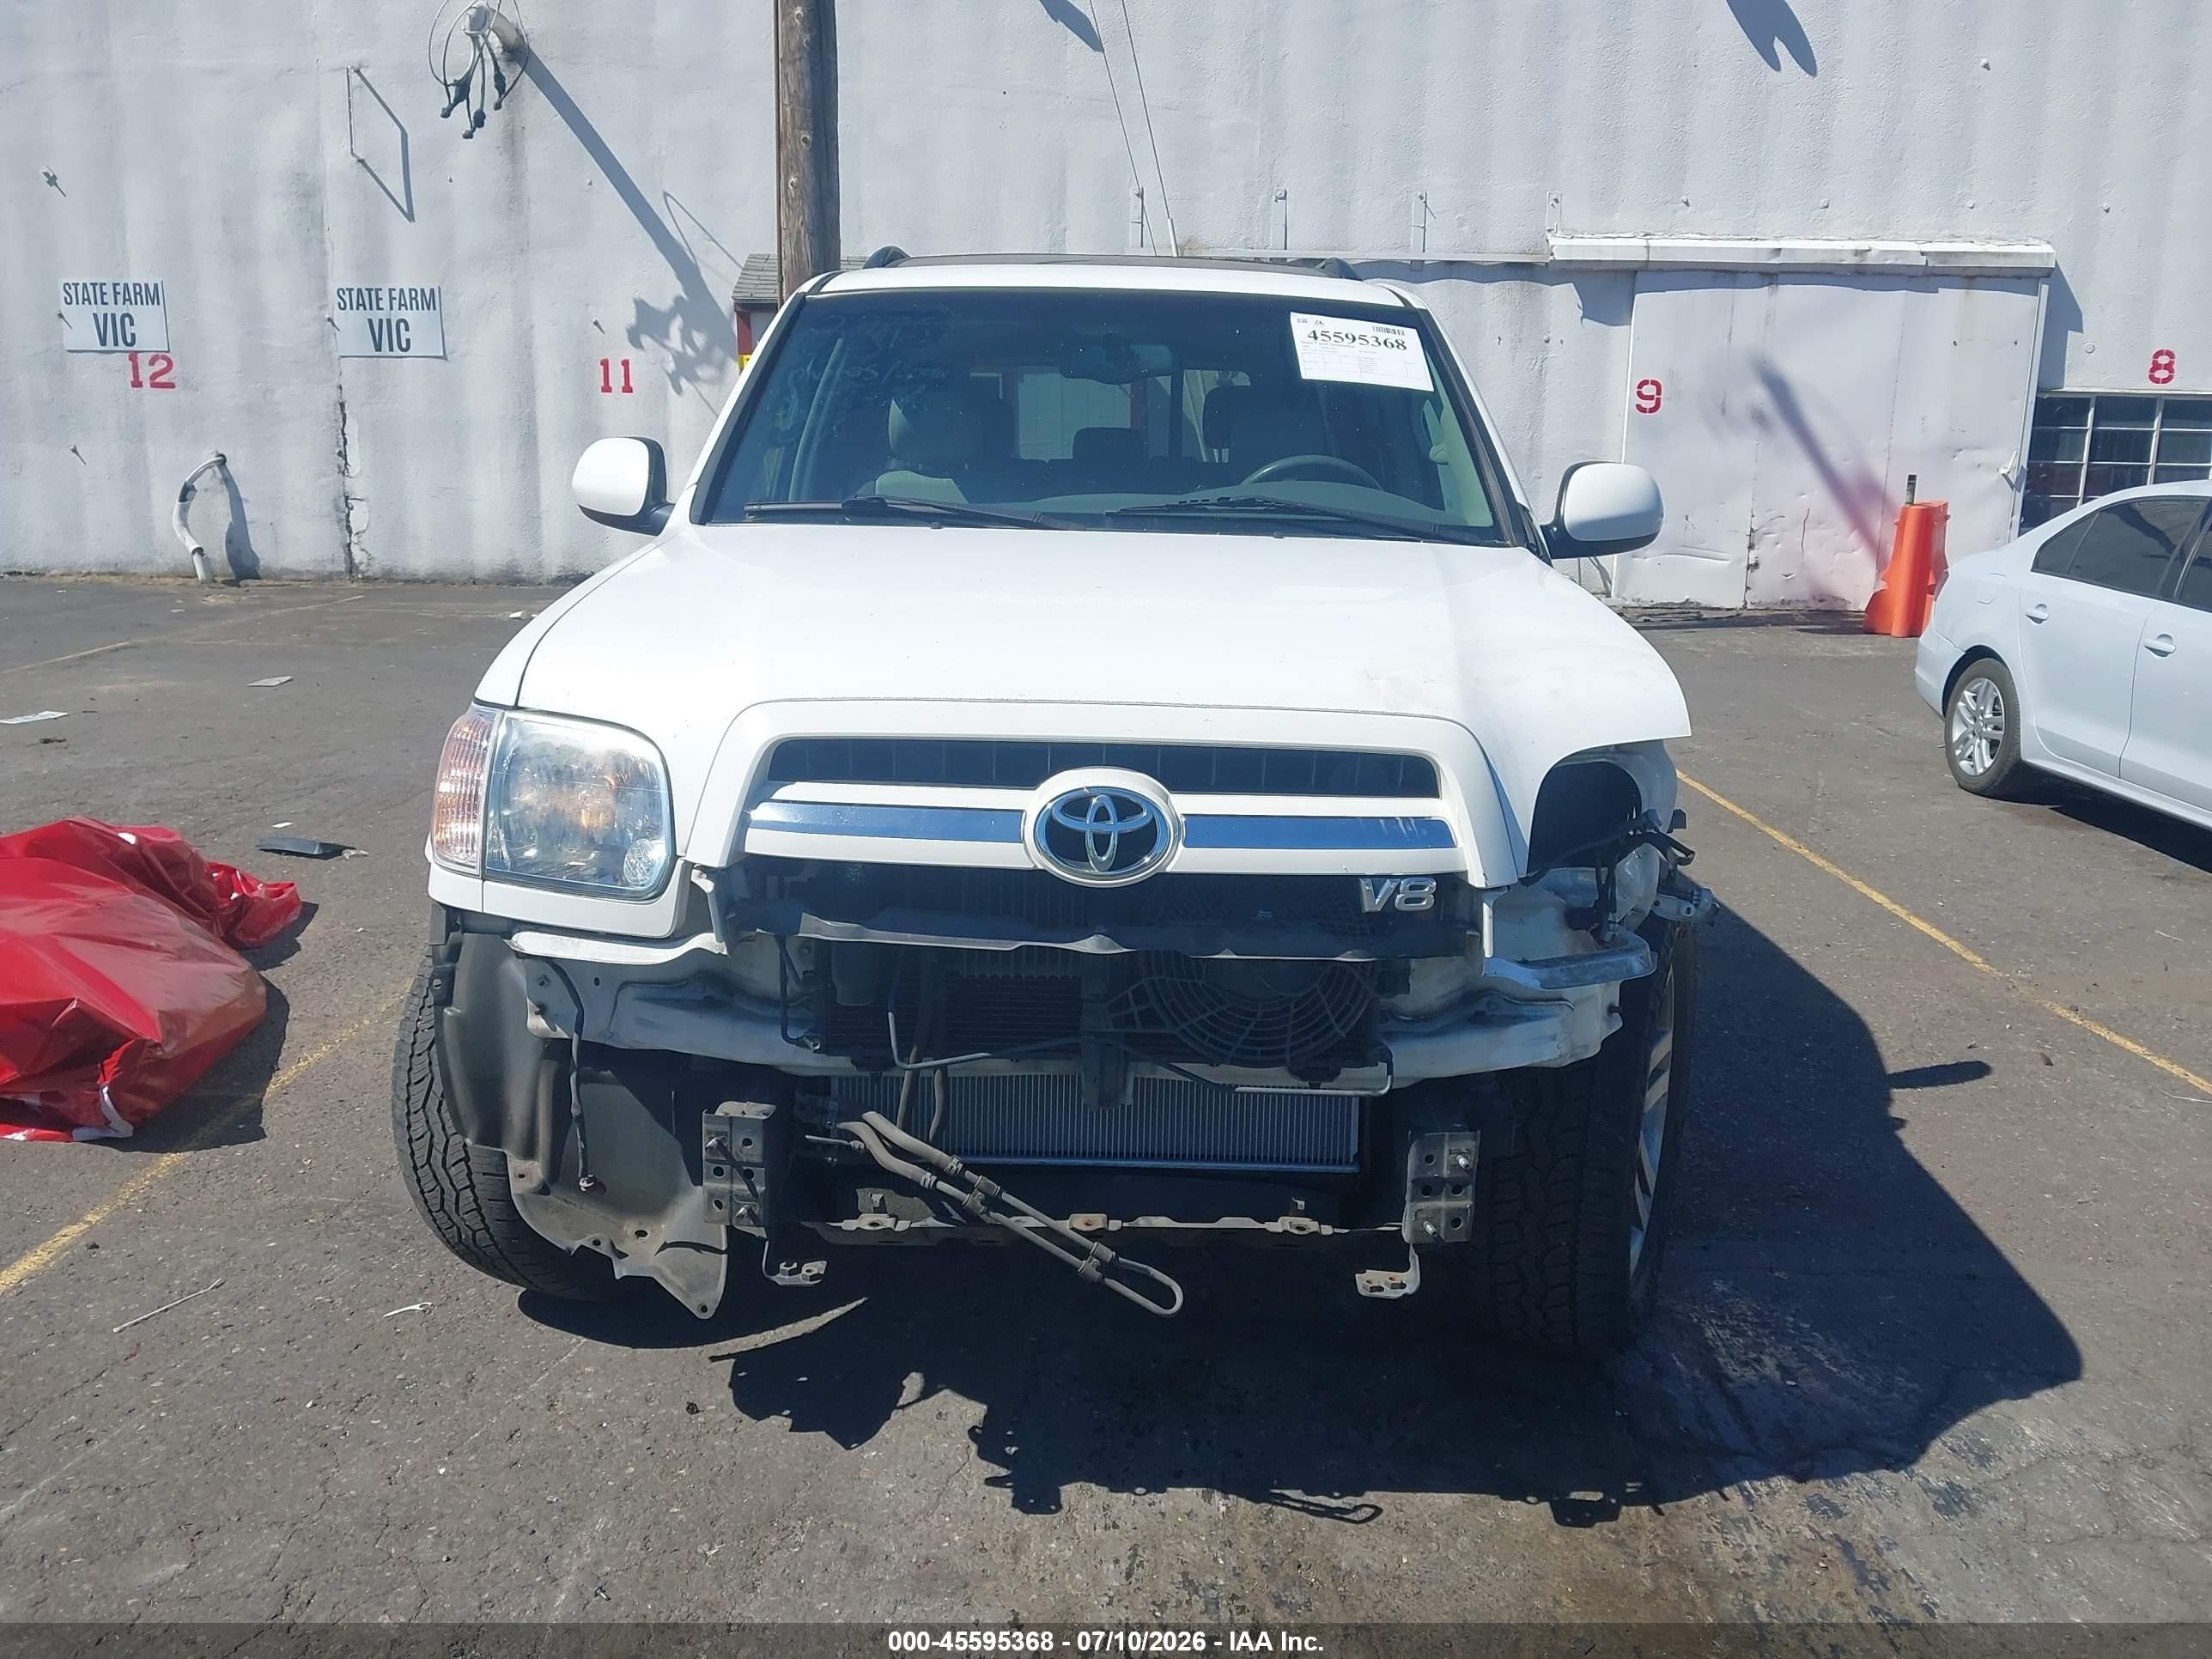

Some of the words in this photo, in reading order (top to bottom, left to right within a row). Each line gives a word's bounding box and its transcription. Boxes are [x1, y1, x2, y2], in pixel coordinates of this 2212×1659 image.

[63, 282, 108, 306] STATE
[112, 282, 161, 307] FARM
[336, 287, 384, 311] STATE
[387, 287, 436, 311] FARM
[92, 312, 137, 348] VIC
[367, 318, 411, 353] VIC
[1306, 329, 1407, 351] 45595368
[128, 351, 176, 389] 12
[599, 358, 634, 393] 11
[2148, 349, 2176, 385] 8
[1635, 379, 1662, 414] 9
[1358, 877, 1437, 913] V8
